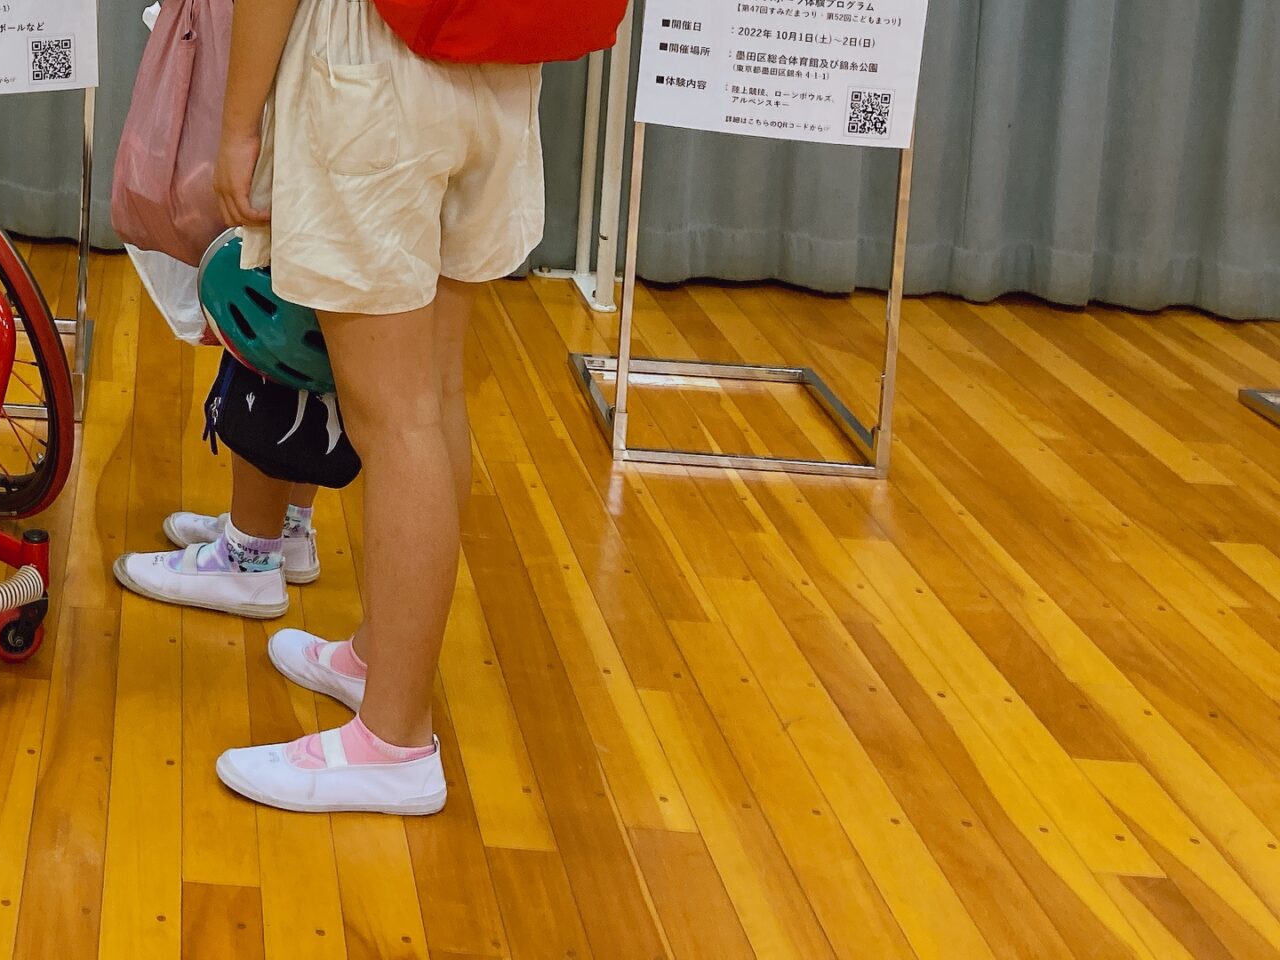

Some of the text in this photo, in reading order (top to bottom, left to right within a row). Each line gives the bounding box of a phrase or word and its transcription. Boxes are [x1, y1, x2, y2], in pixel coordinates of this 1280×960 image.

[671, 19, 703, 32] 開催日
[668, 42, 711, 57] 開催場所
[665, 75, 707, 90] 体験内容
